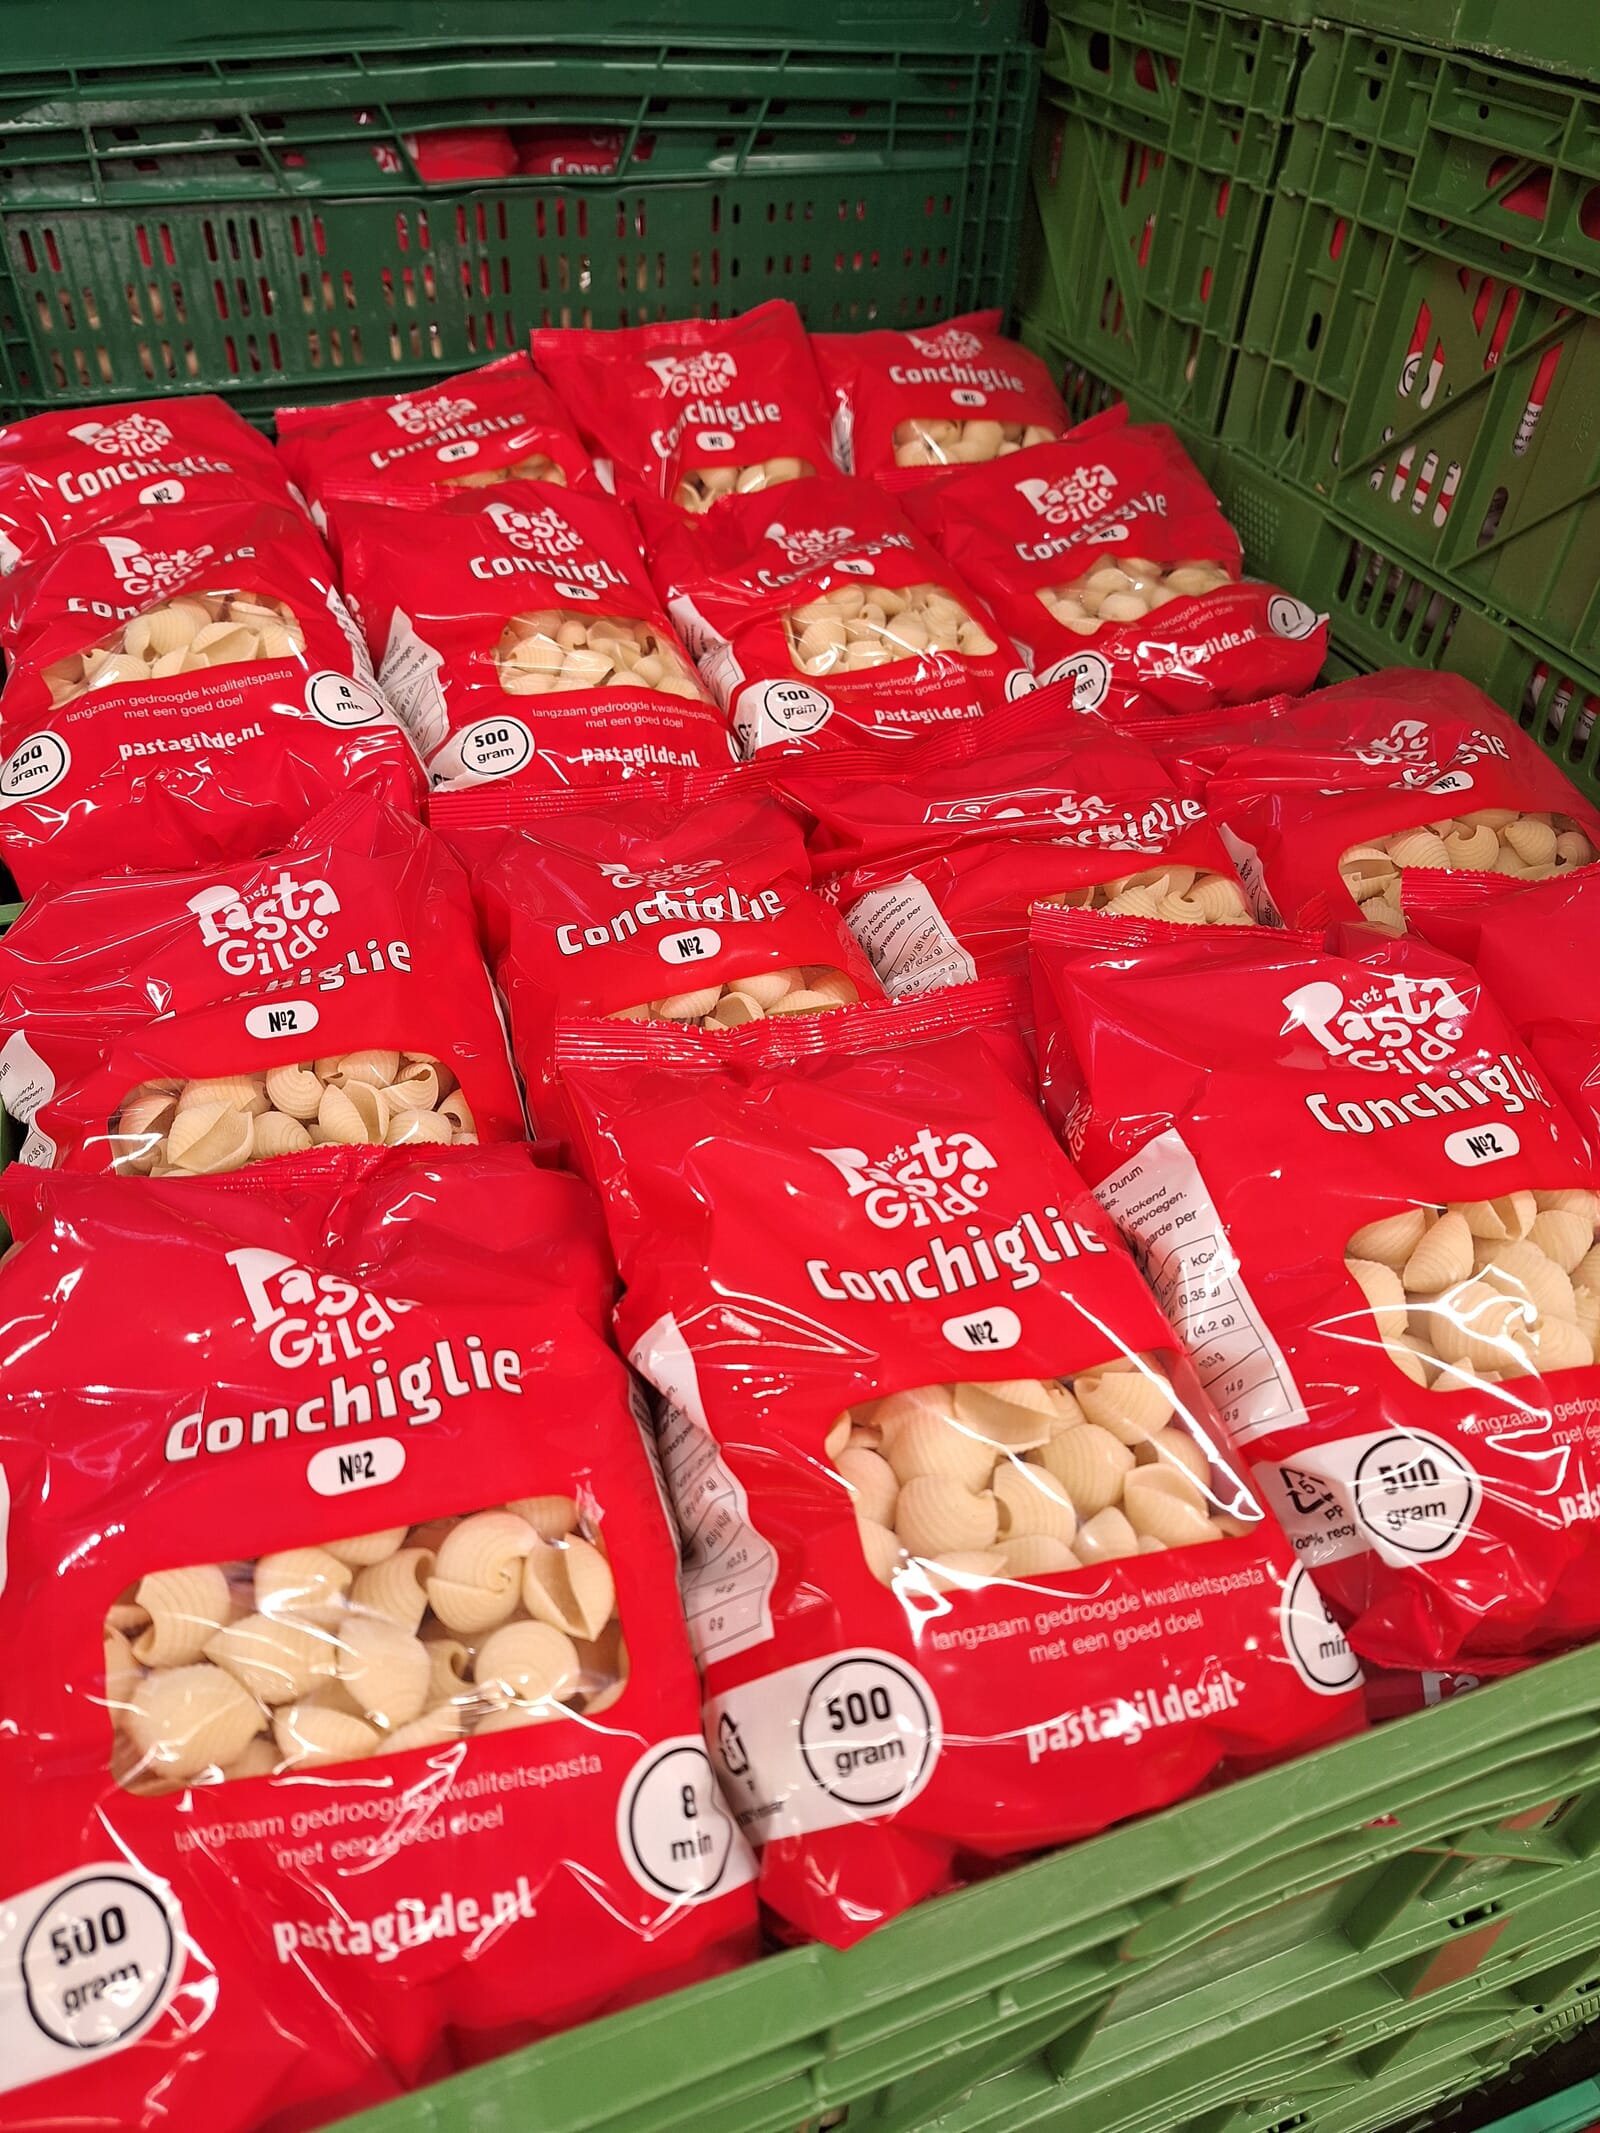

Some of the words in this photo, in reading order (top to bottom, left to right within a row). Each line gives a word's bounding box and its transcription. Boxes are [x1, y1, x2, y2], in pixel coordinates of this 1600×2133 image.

[889, 363, 1024, 393] Conchiglie
[1015, 464, 1118, 515] Pasta
[483, 503, 568, 538] Past
[1045, 487, 1113, 524] Gilde
[508, 529, 584, 556] Gilde
[66, 695, 126, 723] langzaam
[129, 687, 199, 707] gedroogde
[201, 669, 293, 696] kwaliteitspasta
[340, 685, 350, 698] 8
[778, 690, 810, 701] 500
[915, 683, 941, 696] goed
[944, 676, 966, 688] doel
[1073, 678, 1095, 697] ram
[123, 707, 150, 720] met
[153, 705, 177, 718] een
[180, 699, 214, 718] goed
[216, 693, 244, 713] doel
[533, 704, 588, 718] langzaam
[590, 699, 650, 716] gedroogde
[585, 718, 609, 728] met
[611, 716, 632, 727] een
[634, 714, 660, 729] goed
[662, 716, 684, 728] doel
[783, 703, 816, 719] gram
[874, 701, 984, 724] pastagilde.nl
[119, 721, 265, 761] pastagilde.nl
[474, 727, 509, 748] 500
[11, 744, 43, 773] 500
[477, 746, 515, 764] gram
[581, 745, 700, 769] pastagilde.nl
[10, 761, 49, 787] gram
[186, 872, 341, 947] Pasta
[556, 886, 786, 956] Conchiglie
[871, 896, 916, 936] toevoegen.
[217, 919, 329, 976] Gilde
[1349, 985, 1383, 1011] het
[1282, 973, 1473, 1056] Pasta
[1347, 1022, 1464, 1075] Gilde
[876, 1144, 909, 1171] het
[1109, 1166, 1144, 1194] Durum
[865, 1171, 989, 1230] Gilde
[1125, 1186, 1166, 1217] kokend
[1175, 1210, 1197, 1228] per
[165, 1336, 524, 1462] Conchiglie
[1552, 1426, 1583, 1445] met
[1386, 1501, 1447, 1531] gram
[931, 1617, 1031, 1651] langzaam
[1035, 1596, 1141, 1636] gedroogde
[1144, 1567, 1266, 1609] kwaliteitspasta
[1028, 1636, 1069, 1664] met
[1072, 1632, 1110, 1656] een
[1113, 1620, 1162, 1651] goed
[1165, 1609, 1203, 1635] doel
[827, 1686, 891, 1731] 500
[1026, 1674, 1240, 1764] pastagilde.nl
[835, 1738, 906, 1777] gram
[682, 1785, 697, 1819] 8
[174, 1813, 285, 1852] langzaam
[276, 1841, 323, 1869] met
[451, 1804, 504, 1833] doel
[671, 1832, 713, 1862] min
[51, 1906, 126, 1966] 500
